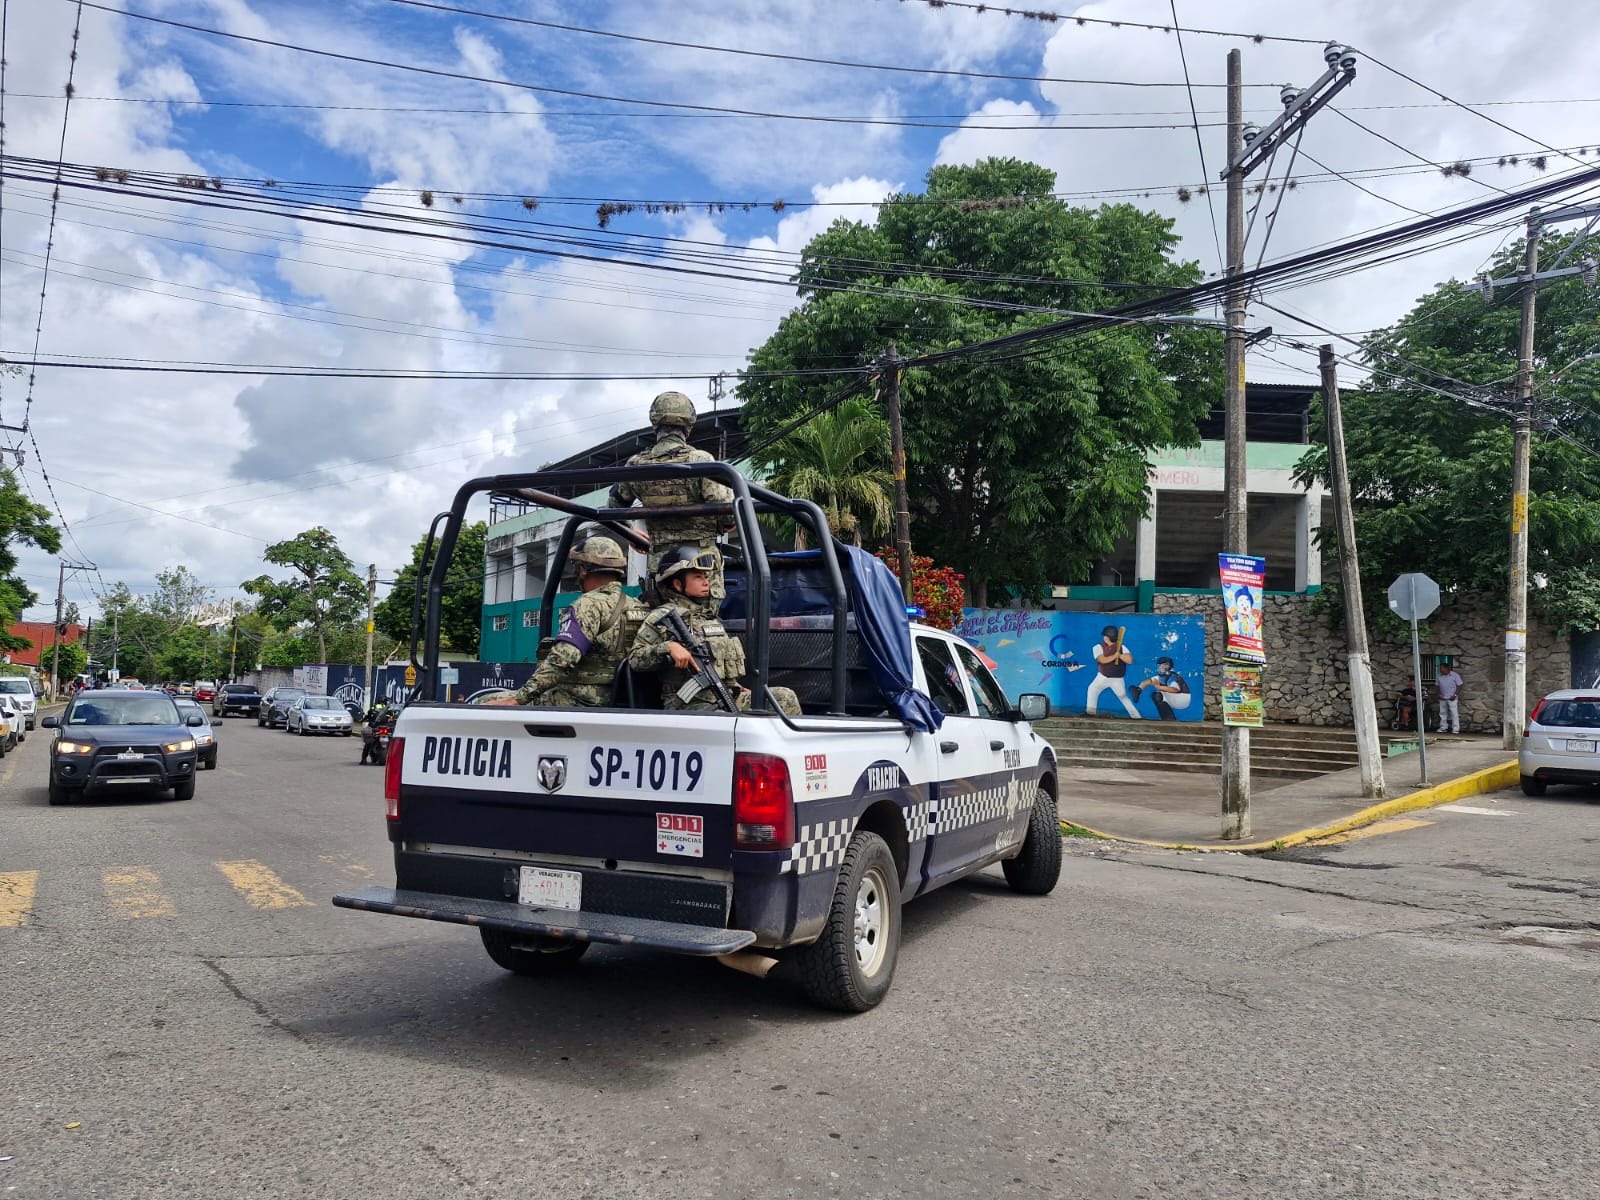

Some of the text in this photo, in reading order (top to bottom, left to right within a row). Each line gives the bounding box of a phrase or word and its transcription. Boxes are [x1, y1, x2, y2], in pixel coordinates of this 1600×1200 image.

[1000, 616, 1053, 638] disfruta
[421, 736, 512, 778] POLICIA
[806, 756, 826, 769] 911
[588, 746, 703, 792] SP-1019
[867, 766, 900, 792] VERACRUZ
[660, 816, 699, 831] 911
[658, 834, 703, 844] EMERGENCIAS
[538, 871, 564, 879] VERACRUZ
